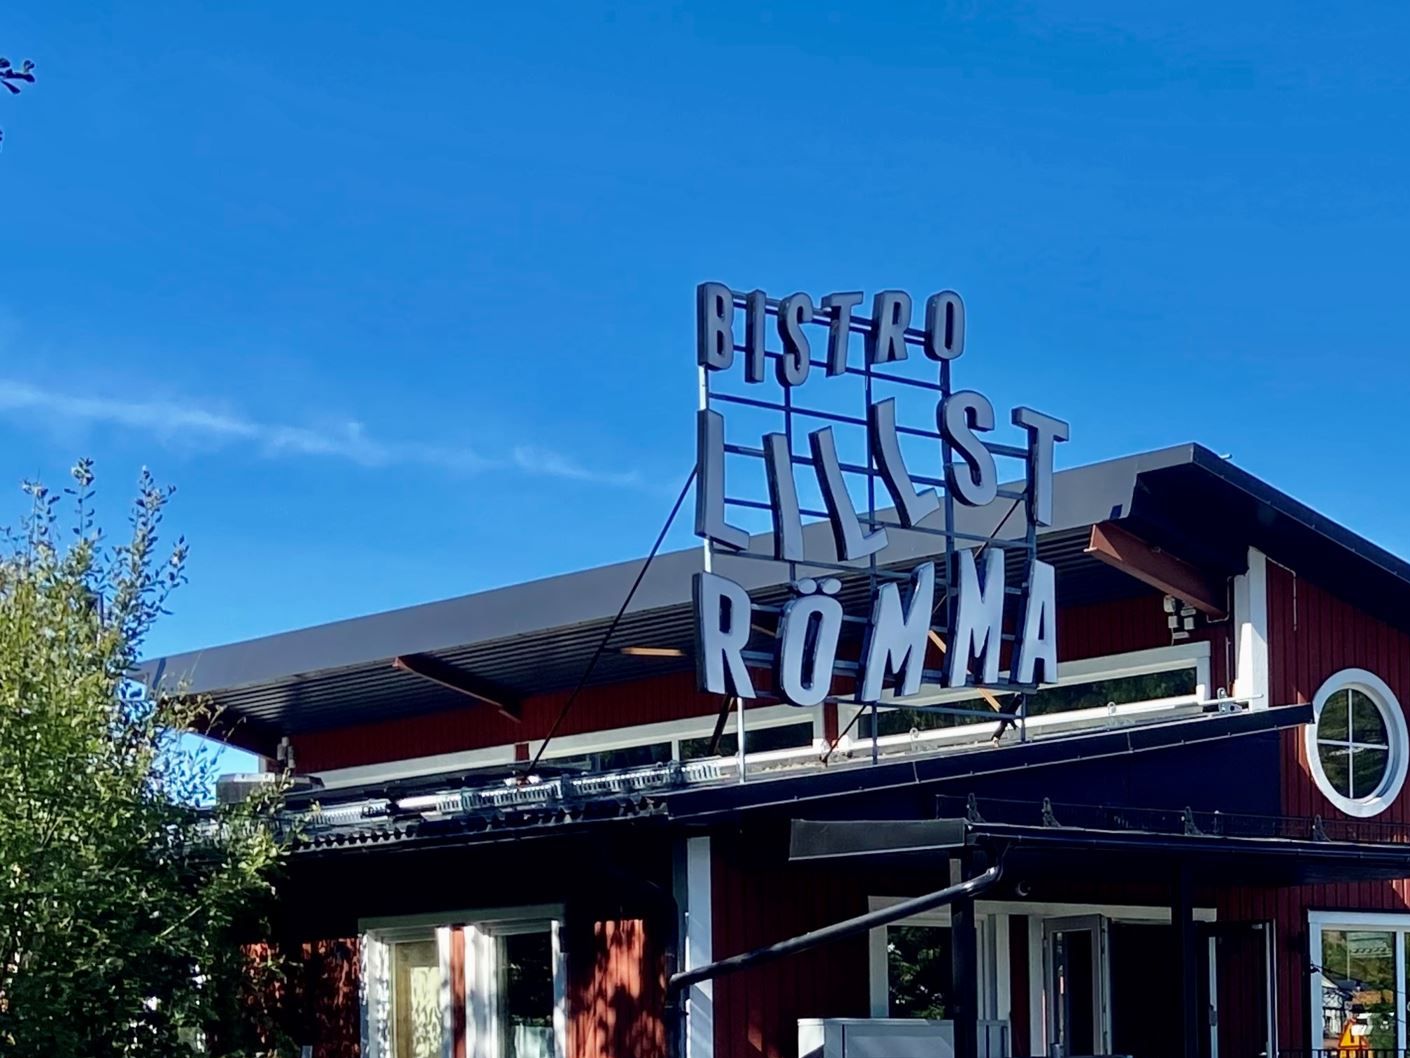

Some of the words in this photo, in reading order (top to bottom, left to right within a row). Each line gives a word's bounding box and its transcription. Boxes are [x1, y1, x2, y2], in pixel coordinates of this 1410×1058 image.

[697, 282, 965, 386] BISTRO
[695, 390, 1069, 562] LILLST
[692, 547, 1058, 707] RÖMMA
